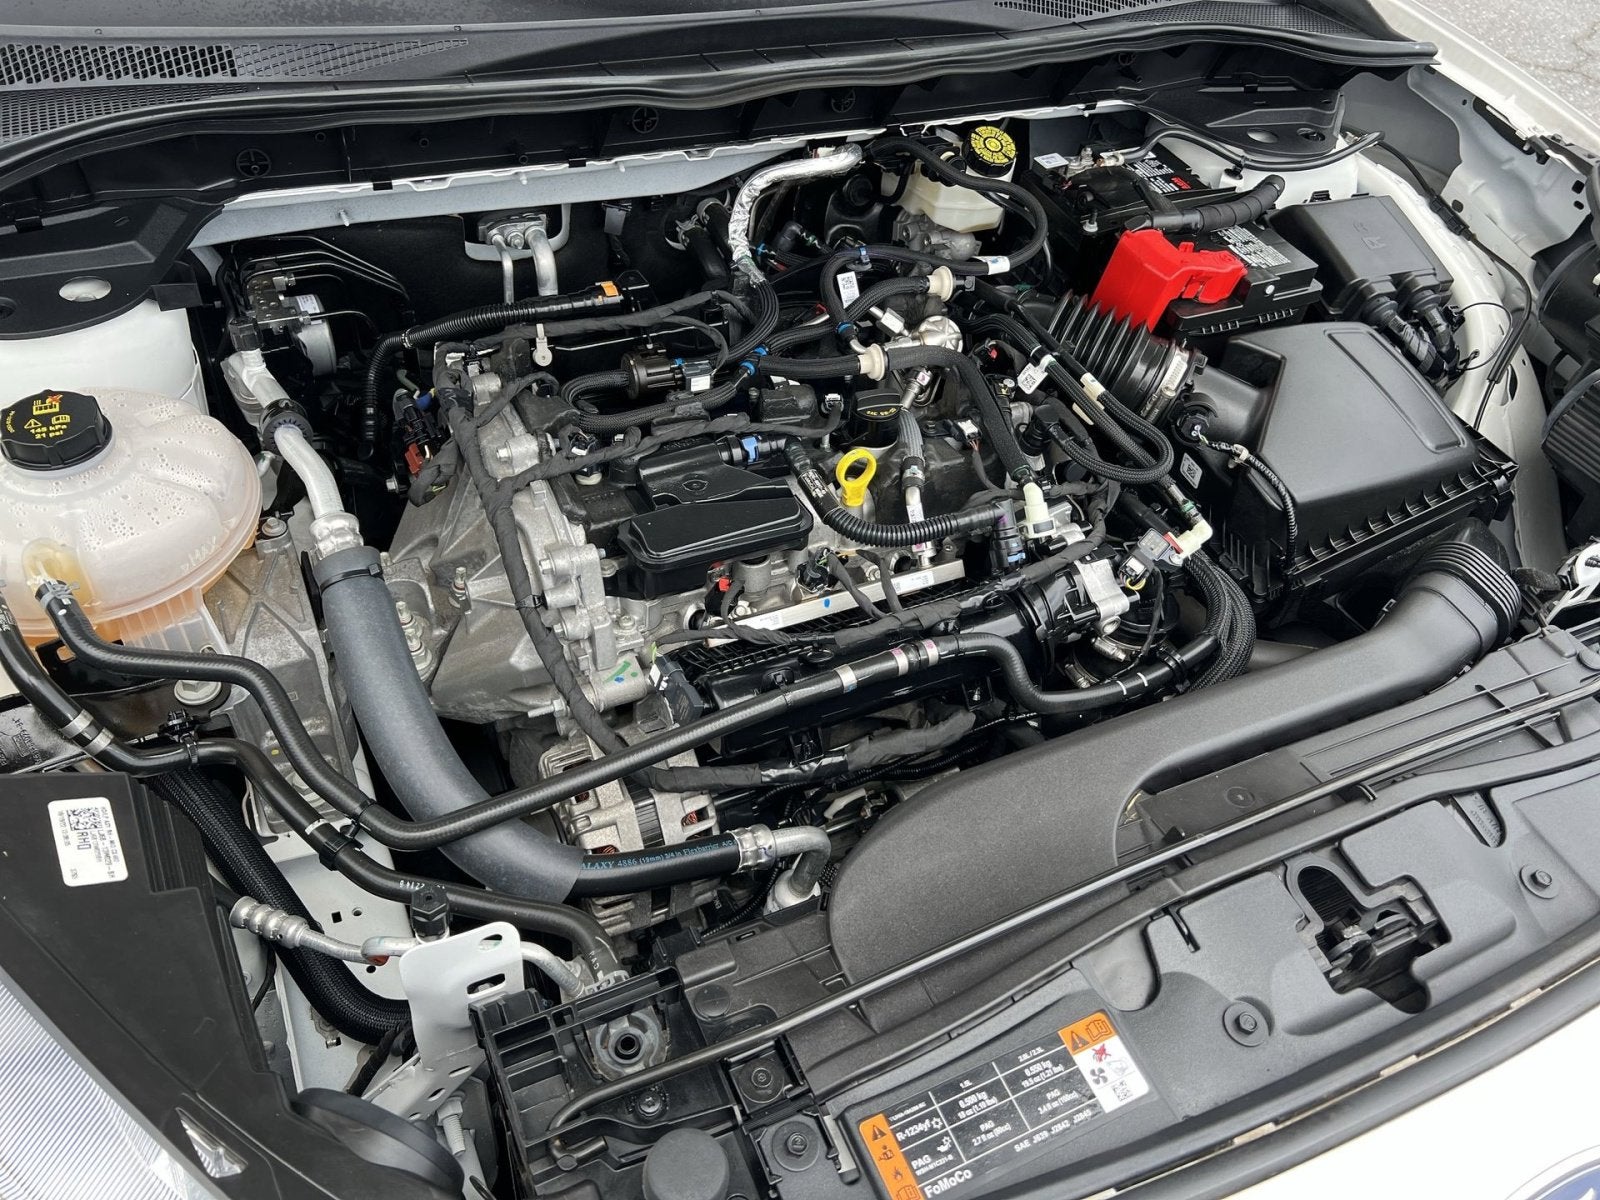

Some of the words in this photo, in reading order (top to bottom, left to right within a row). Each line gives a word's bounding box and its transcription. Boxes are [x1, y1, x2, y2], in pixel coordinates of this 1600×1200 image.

[579, 860, 614, 870] ALAXY
[617, 858, 637, 866] 4886
[1040, 1060, 1053, 1069] kg
[975, 1091, 988, 1100] kg
[1046, 1089, 1061, 1100] PAG
[896, 1119, 931, 1141] R-1234yf
[980, 1120, 995, 1131] PAG
[1014, 1139, 1031, 1152] SAE
[911, 1155, 932, 1169] PAG
[924, 1169, 972, 1198] FoMoCo
